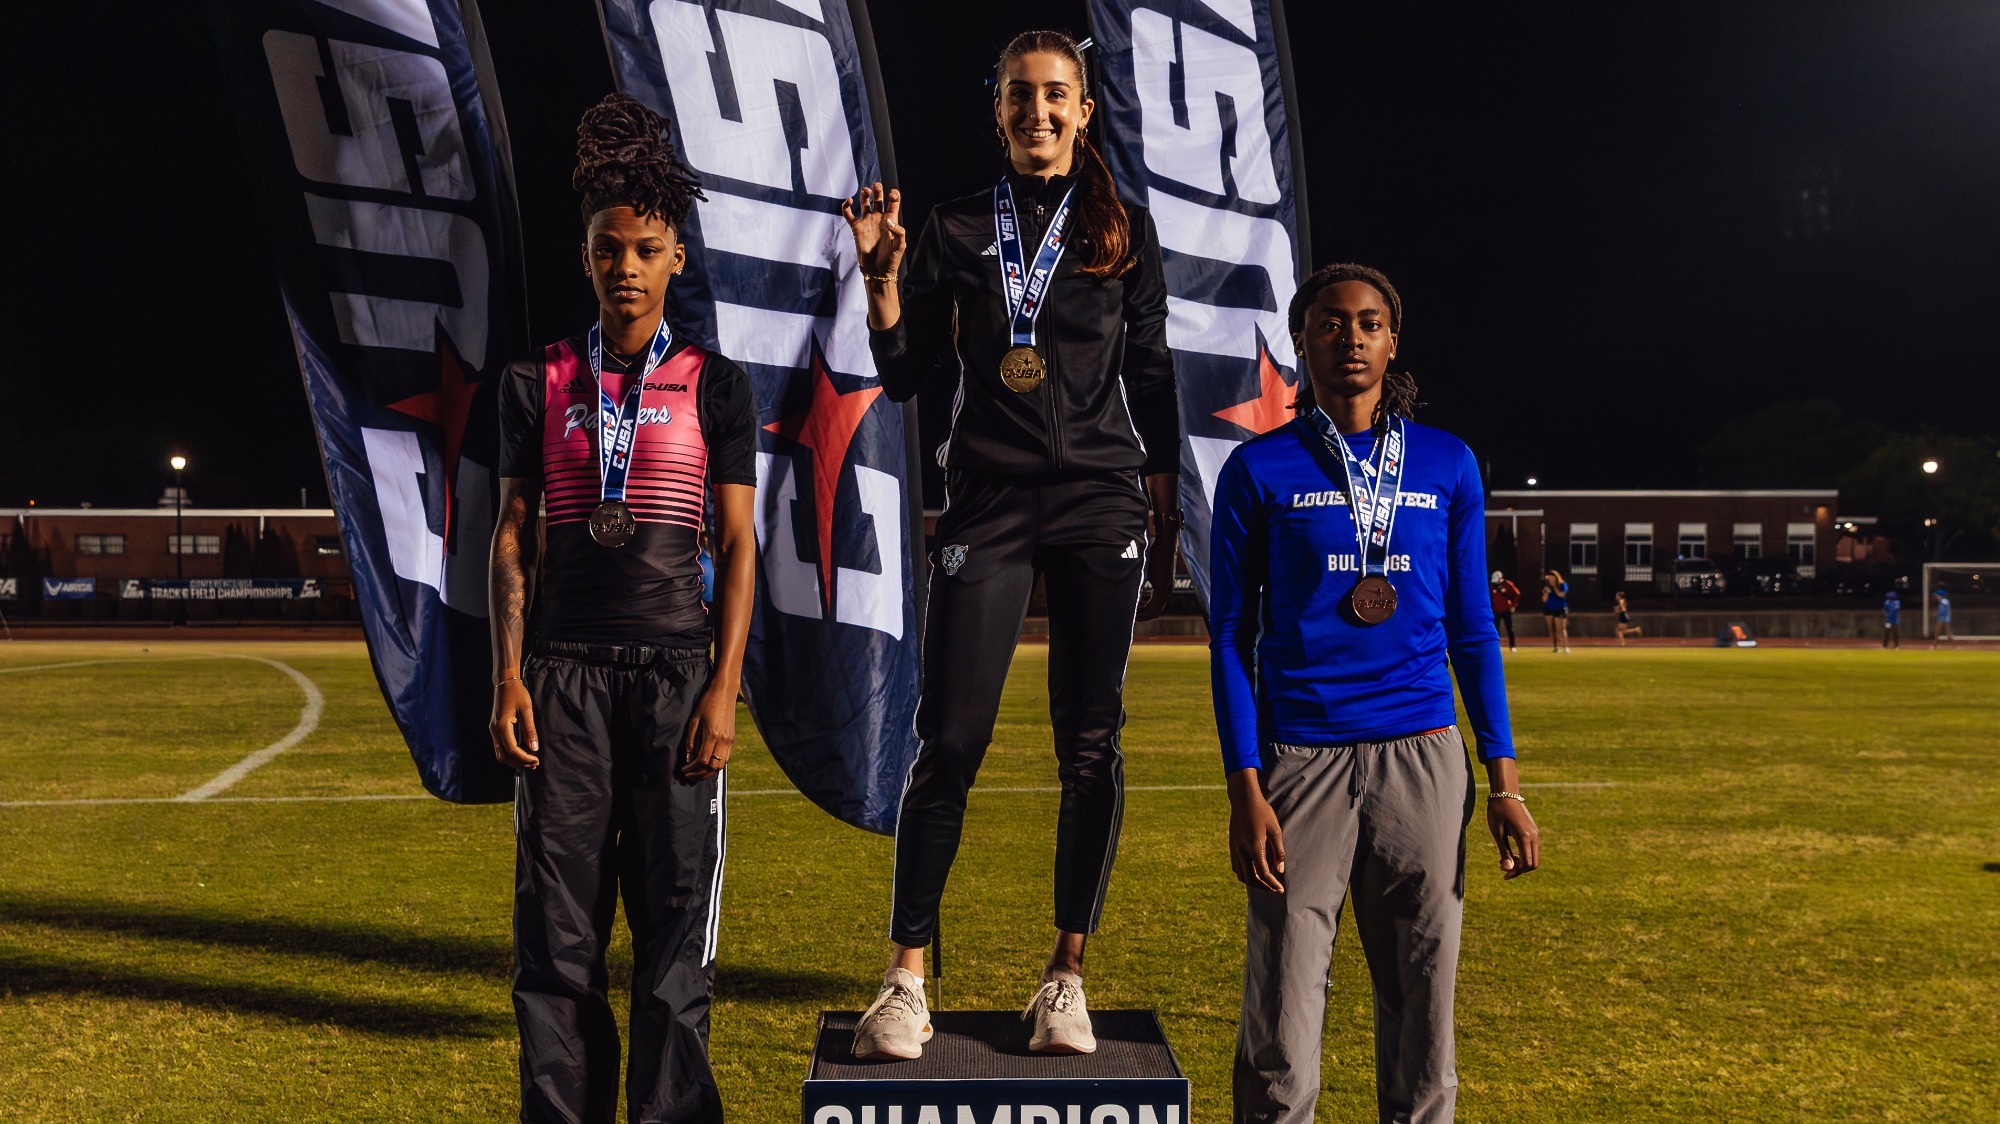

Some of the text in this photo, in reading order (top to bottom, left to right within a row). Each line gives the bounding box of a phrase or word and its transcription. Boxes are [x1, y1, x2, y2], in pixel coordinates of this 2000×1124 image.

[262, 0, 490, 617] CUS
[649, 0, 902, 641] CUS
[565, 403, 672, 439] Paers
[1293, 491, 1350, 508] LOUIS
[1328, 554, 1411, 572] BULGS
[152, 588, 180, 599] TRACK
[191, 588, 215, 599] FIELD
[217, 587, 293, 599] CHAMPIONSHIPS
